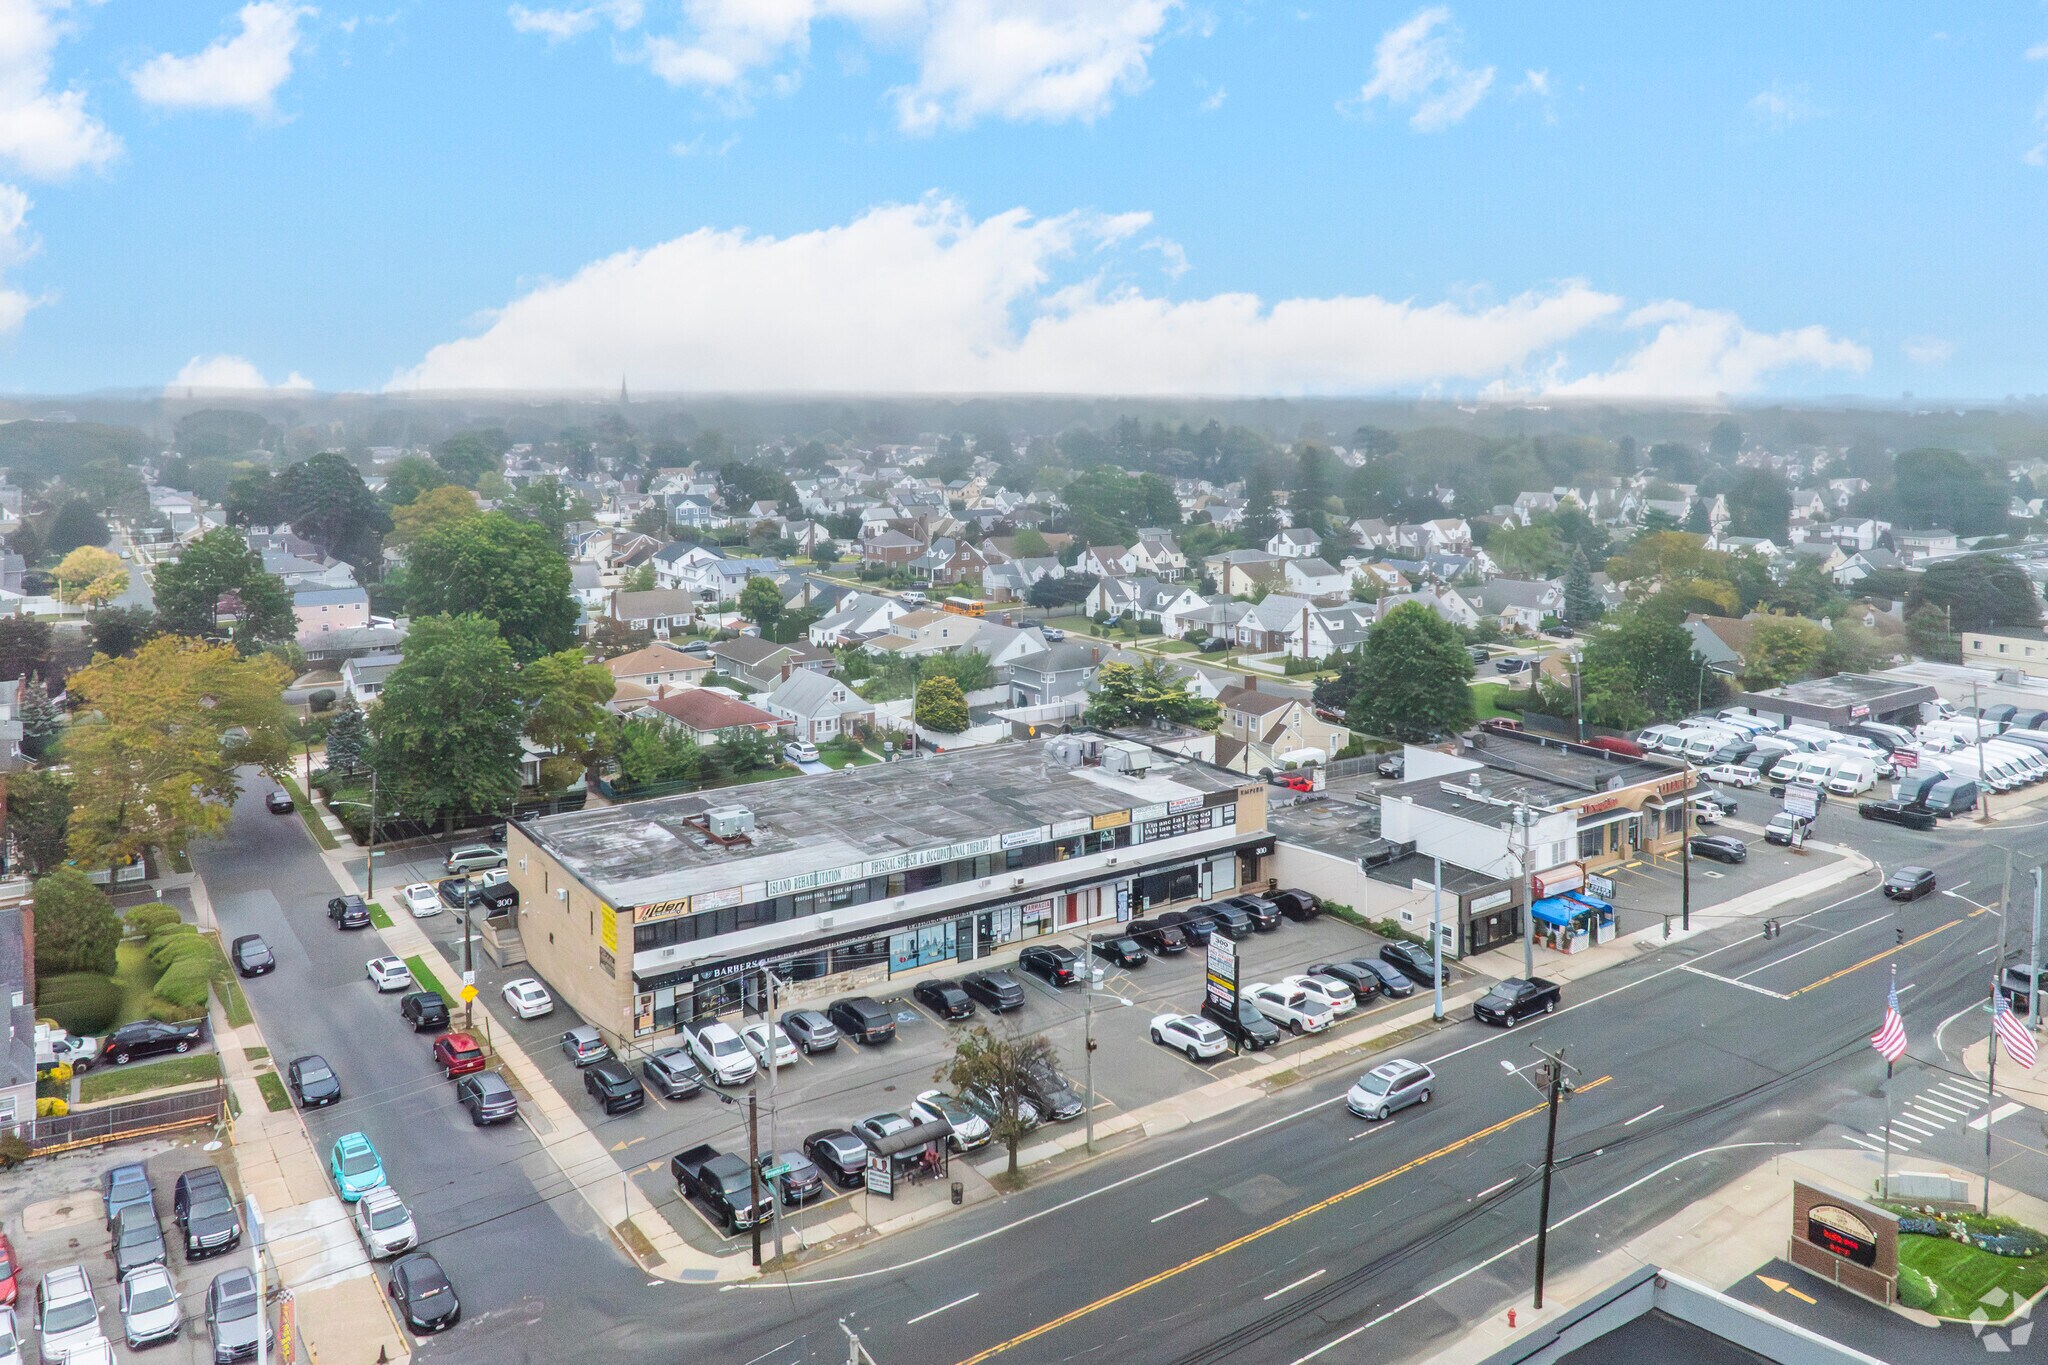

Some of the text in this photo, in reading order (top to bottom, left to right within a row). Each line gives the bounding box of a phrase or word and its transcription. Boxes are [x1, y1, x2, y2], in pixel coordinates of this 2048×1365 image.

[926, 844, 966, 863] OCCUPATIONAL
[966, 840, 990, 856] THERAPY
[1255, 846, 1268, 856] 300
[769, 880, 792, 896] ISLAND
[794, 868, 842, 890] REHABILITATION
[496, 898, 513, 908] 300
[639, 900, 685, 920] Tilden
[713, 960, 759, 978] BARBERS
